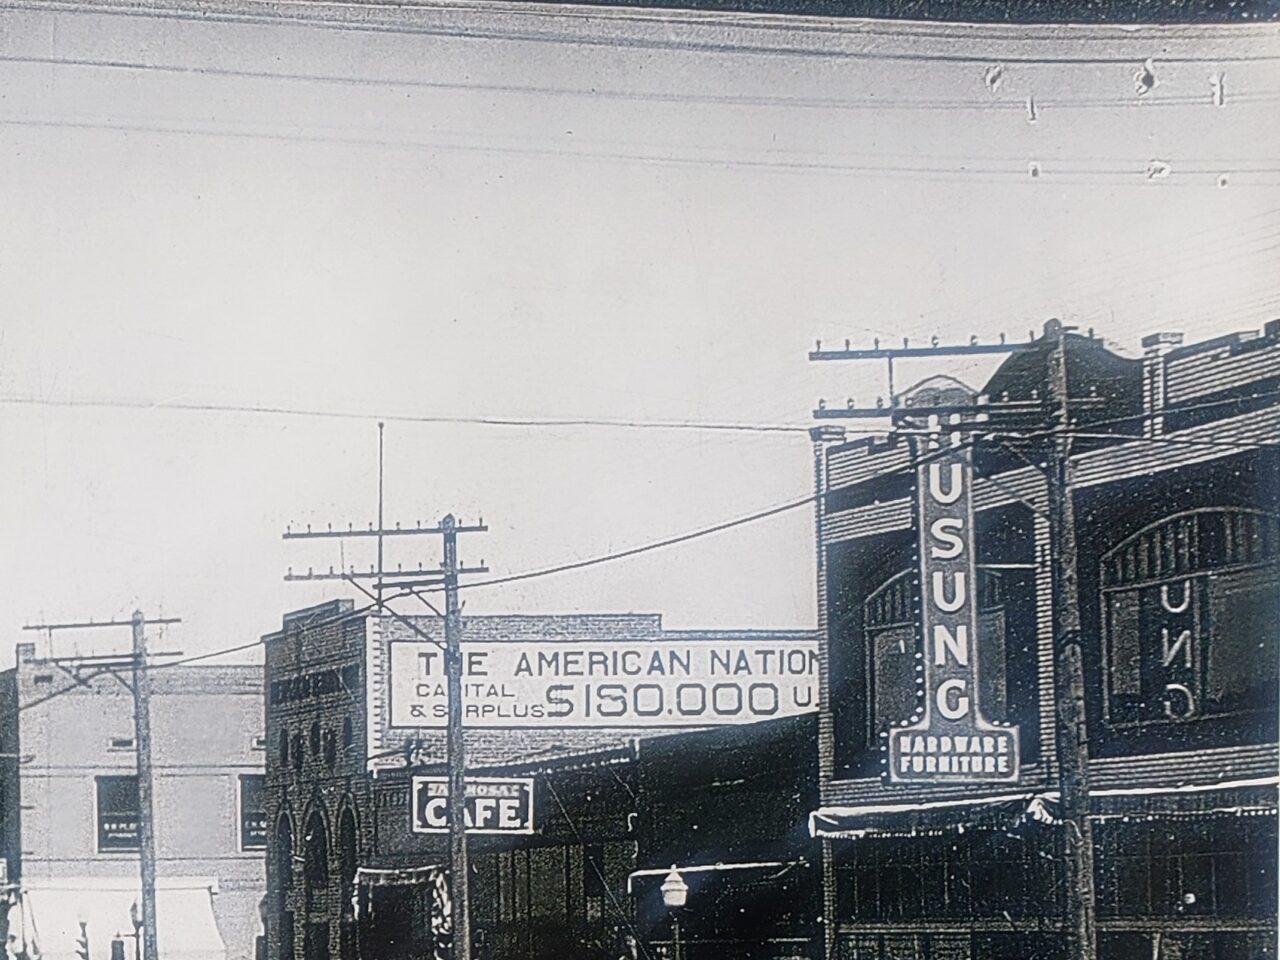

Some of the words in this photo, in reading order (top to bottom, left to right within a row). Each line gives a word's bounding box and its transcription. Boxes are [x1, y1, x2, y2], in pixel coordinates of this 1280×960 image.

[514, 650, 691, 677] AMERICAN
[416, 683, 516, 699] CAITAL
[432, 704, 545, 719] SRPLUS
[900, 735, 1008, 753] HARDWARE
[900, 756, 1009, 773] FURNITURE
